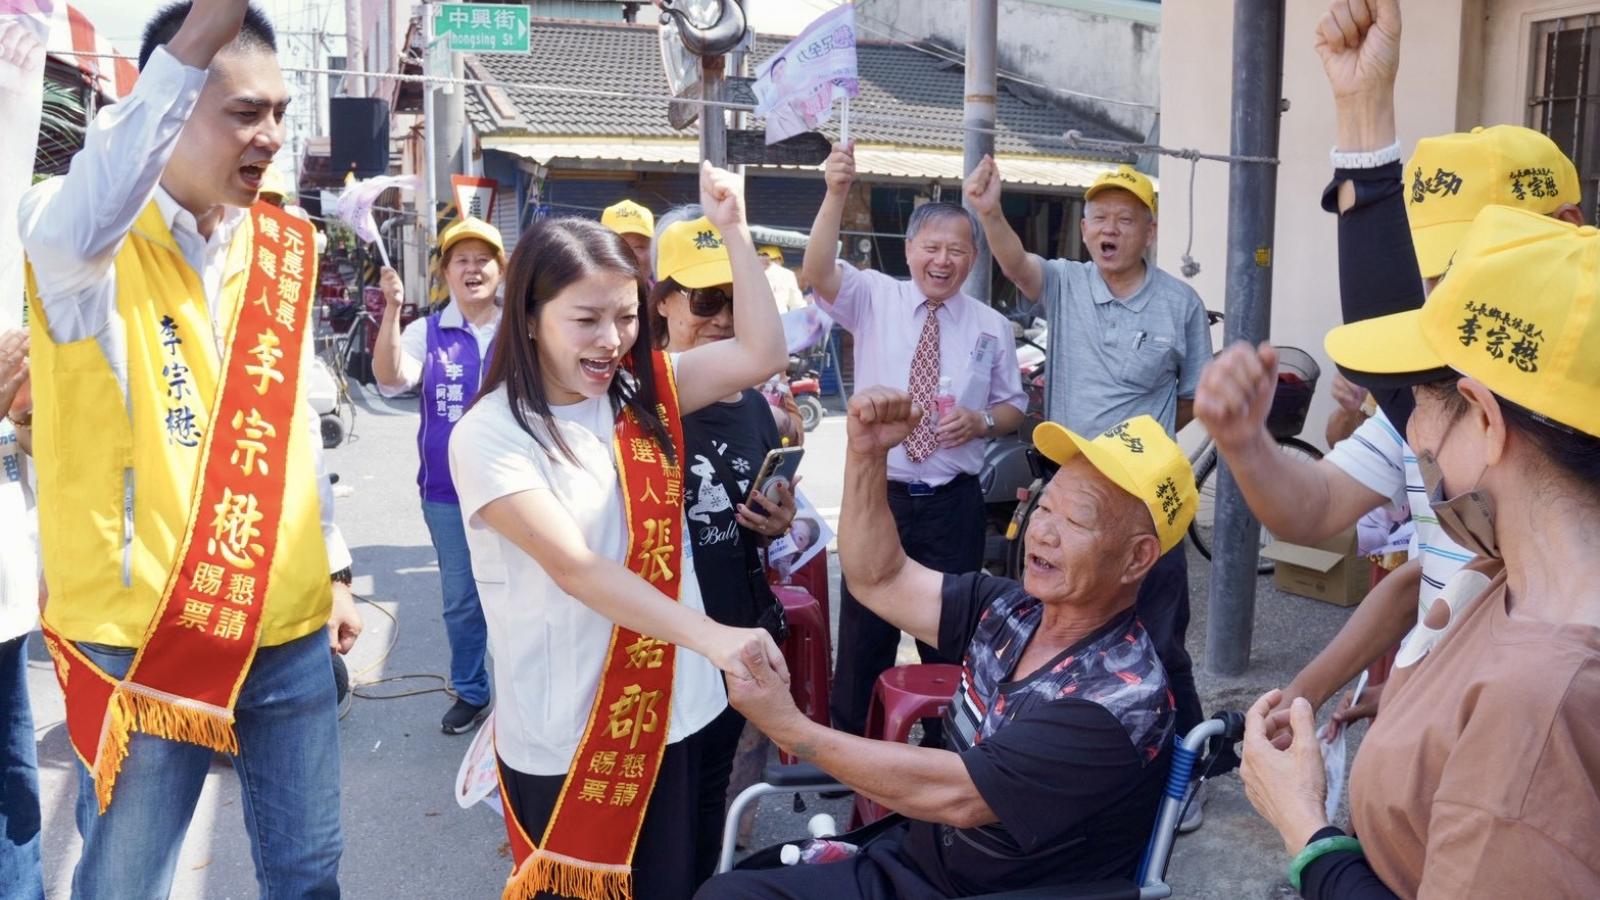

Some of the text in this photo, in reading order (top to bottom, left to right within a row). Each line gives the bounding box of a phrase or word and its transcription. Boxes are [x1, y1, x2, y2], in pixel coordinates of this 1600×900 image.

[448, 6, 516, 30] 中興街
[452, 31, 496, 49] hongsing
[253, 213, 280, 317] 候選人
[275, 226, 305, 332] 元長鄉長
[1456, 313, 1540, 374] 李宗懋
[159, 314, 203, 448] 李宗懋
[207, 327, 285, 569] 李宗懋
[626, 405, 662, 505] 選人
[177, 561, 226, 634] 賜票
[213, 572, 257, 642] 懇請
[577, 751, 619, 805] 賜票
[609, 753, 647, 808] 懇請
